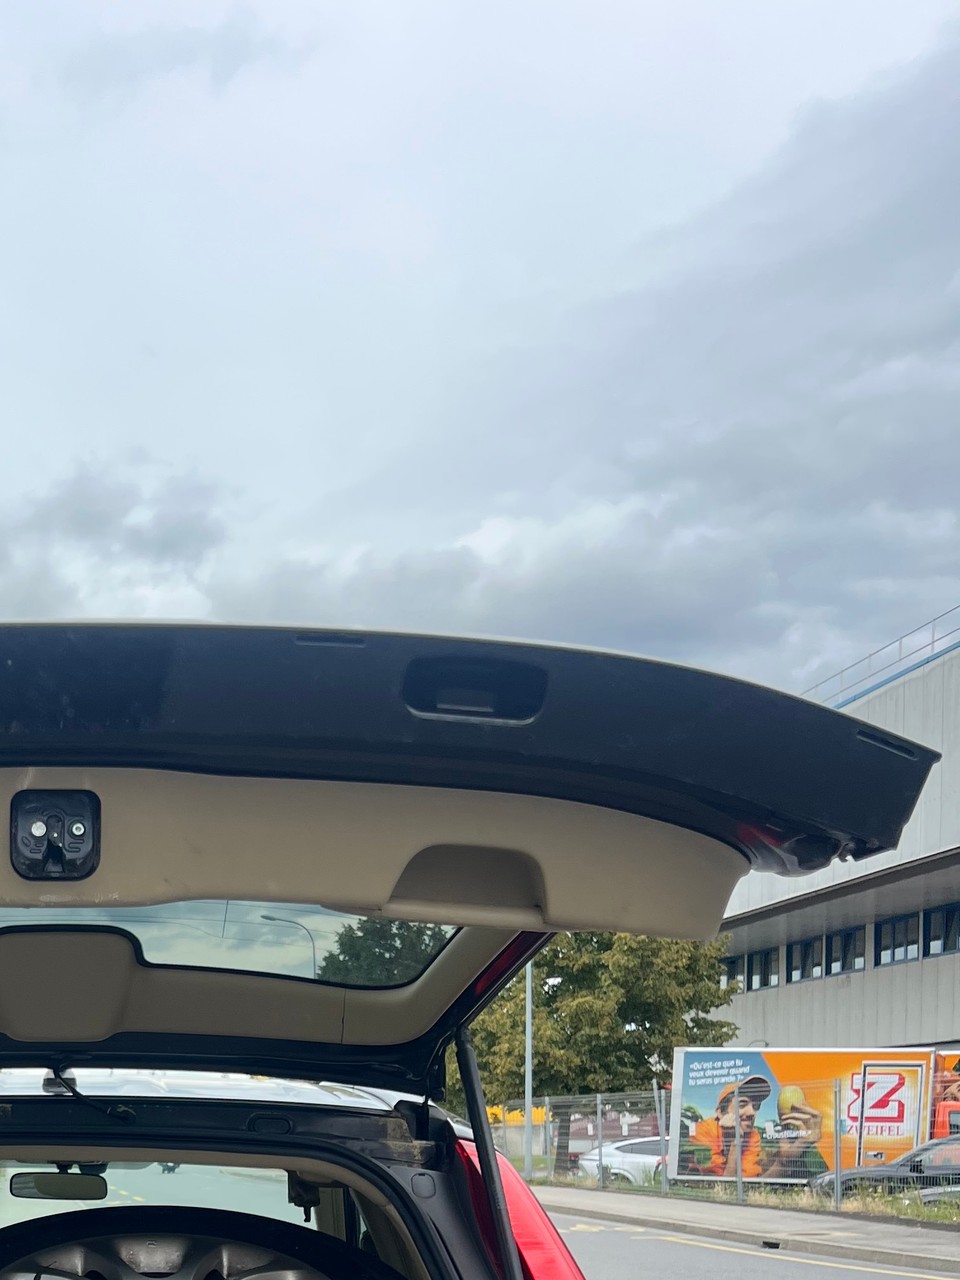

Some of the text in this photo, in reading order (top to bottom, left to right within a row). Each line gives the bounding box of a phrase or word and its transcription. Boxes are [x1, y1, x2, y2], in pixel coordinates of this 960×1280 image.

[722, 1059, 735, 1067] que
[735, 1058, 743, 1066] tu
[688, 1065, 750, 1078] veux devenir quand
[688, 1078, 696, 1086] tu
[696, 1077, 713, 1085] seras
[713, 1075, 736, 1085] grande
[847, 1072, 905, 1123] Z
